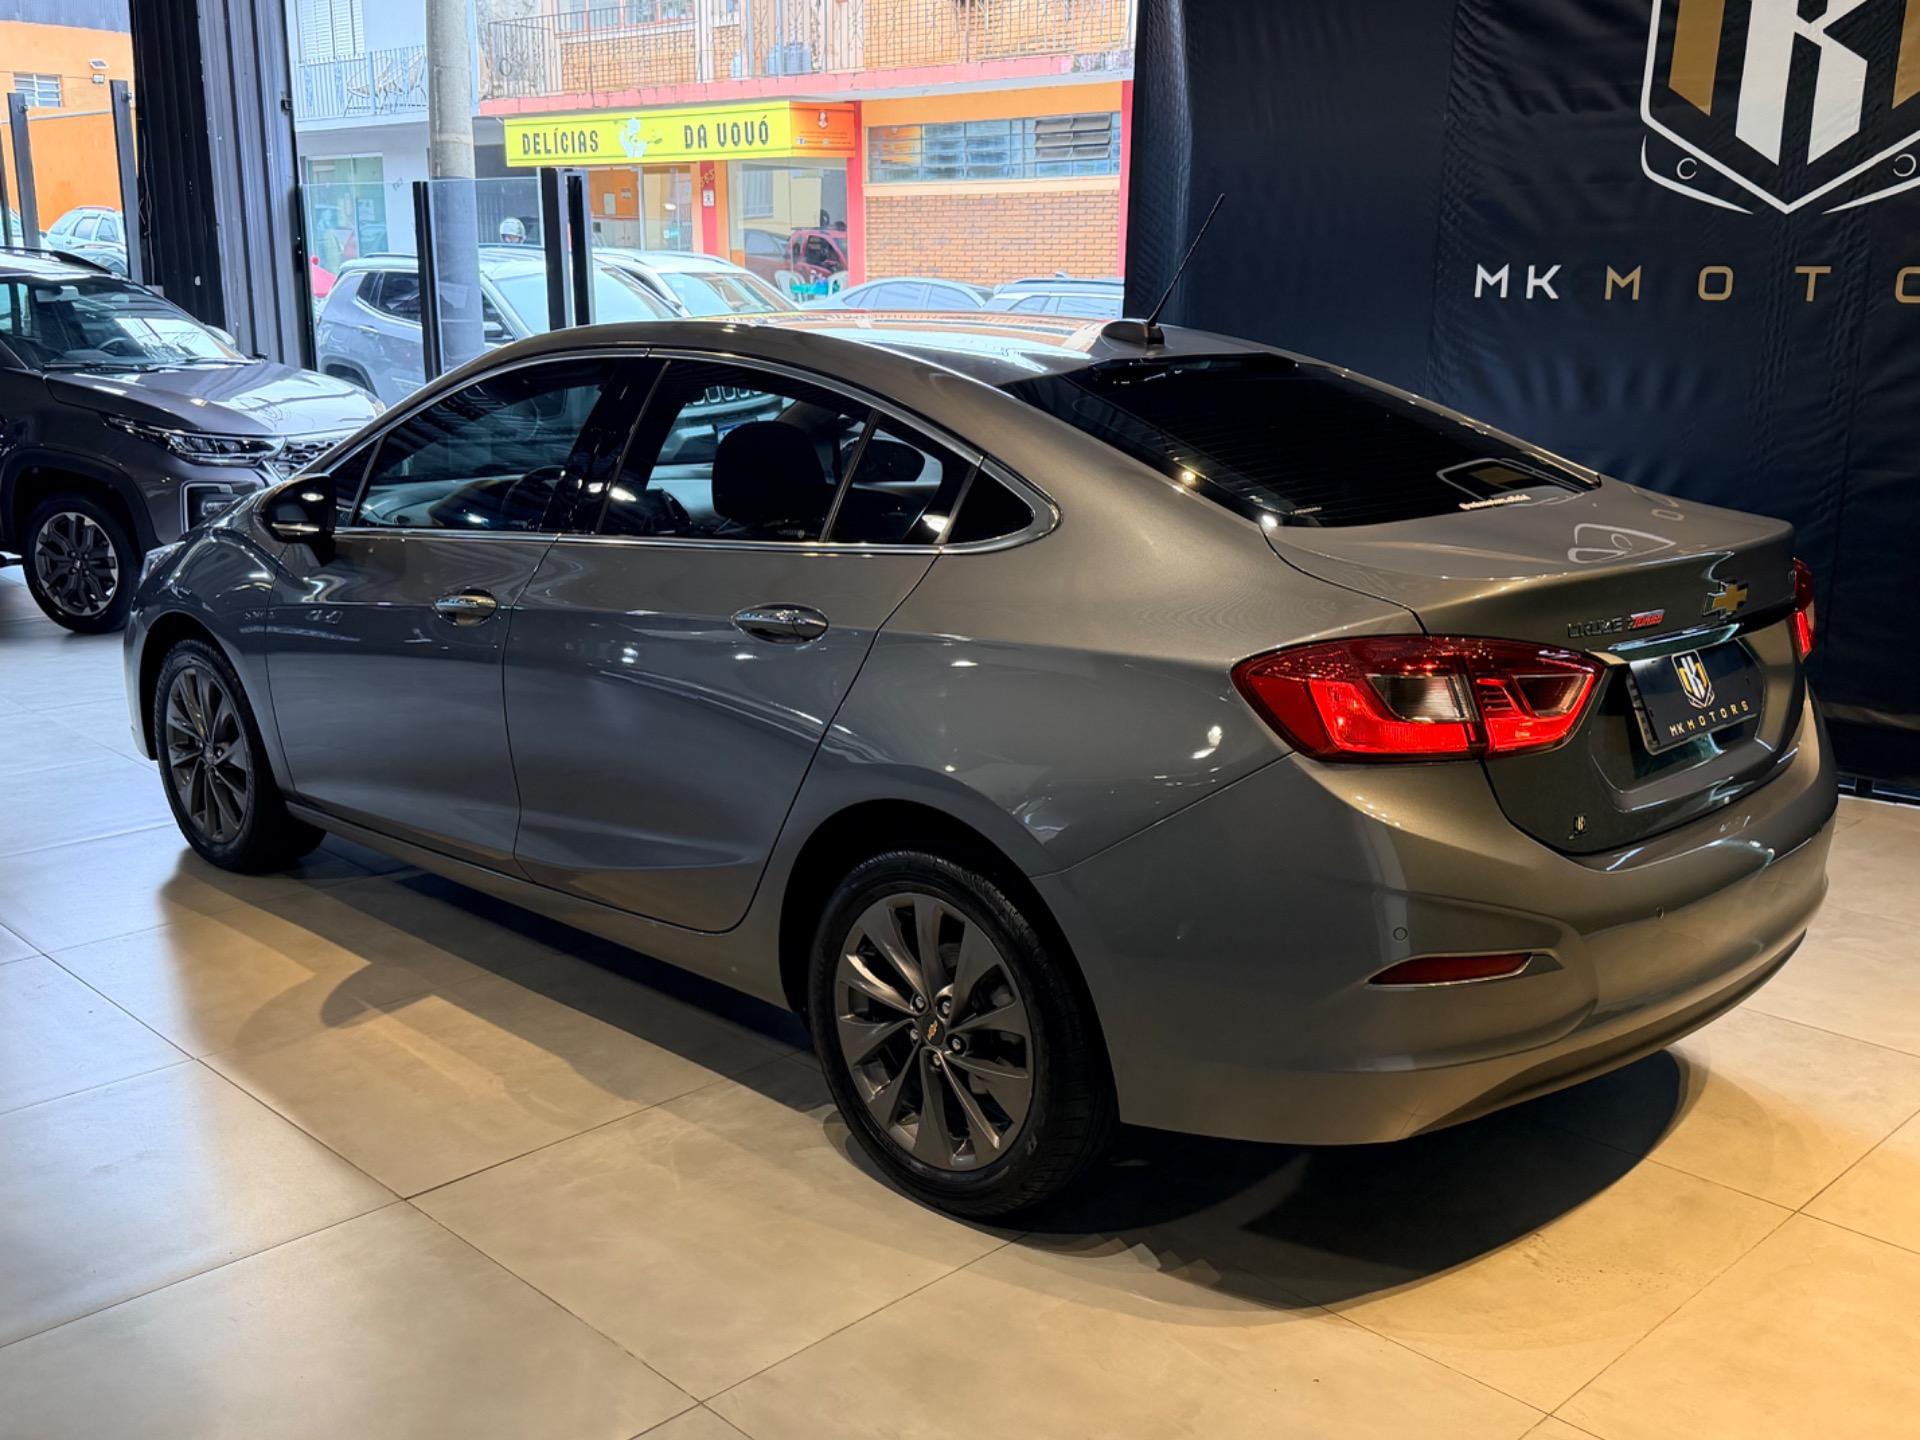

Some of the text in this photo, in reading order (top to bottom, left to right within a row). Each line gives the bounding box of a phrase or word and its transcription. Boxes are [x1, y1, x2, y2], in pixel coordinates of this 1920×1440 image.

[522, 127, 599, 155] DELÍCIAS
[683, 124, 708, 149] DA
[1474, 264, 1562, 299] MK
[1669, 700, 1749, 737] MK MOTORS
